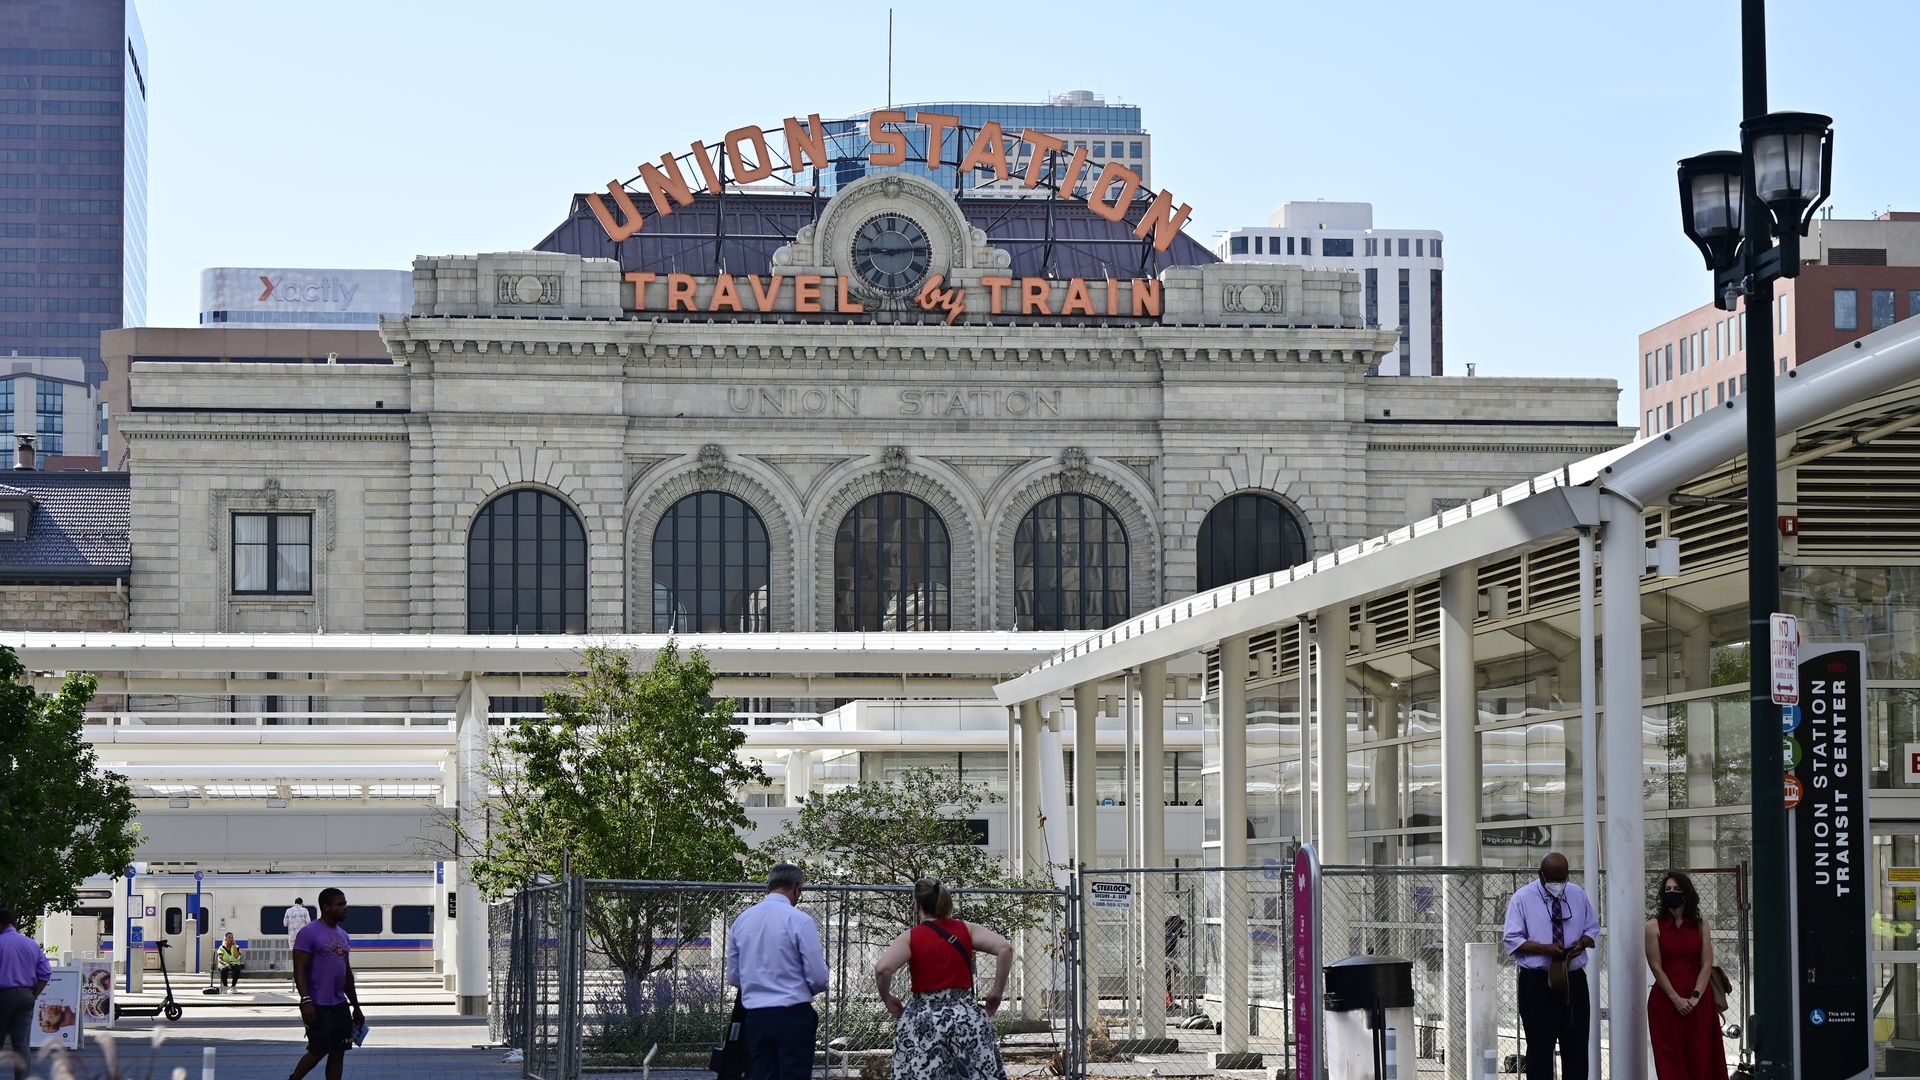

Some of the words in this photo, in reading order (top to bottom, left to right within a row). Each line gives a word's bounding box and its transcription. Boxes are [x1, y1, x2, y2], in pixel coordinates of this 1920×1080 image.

[585, 113, 828, 242] UNION
[868, 111, 1192, 252] STATION
[258, 275, 359, 311] Xactly
[624, 272, 864, 313] TRAVEL
[916, 274, 966, 326] by
[980, 276, 1160, 316] TRAIN
[727, 388, 859, 416] UNION
[900, 390, 1063, 417] STATION
[1773, 640, 1796, 656] STOPPING
[1778, 621, 1789, 637] NO
[1775, 658, 1784, 669] ANY
[1784, 659, 1795, 670] TIME
[1811, 680, 1828, 788] STATION
[1832, 680, 1848, 777] CENTER
[1813, 803, 1830, 885] UNION
[1834, 789, 1850, 897] TRANSIT
